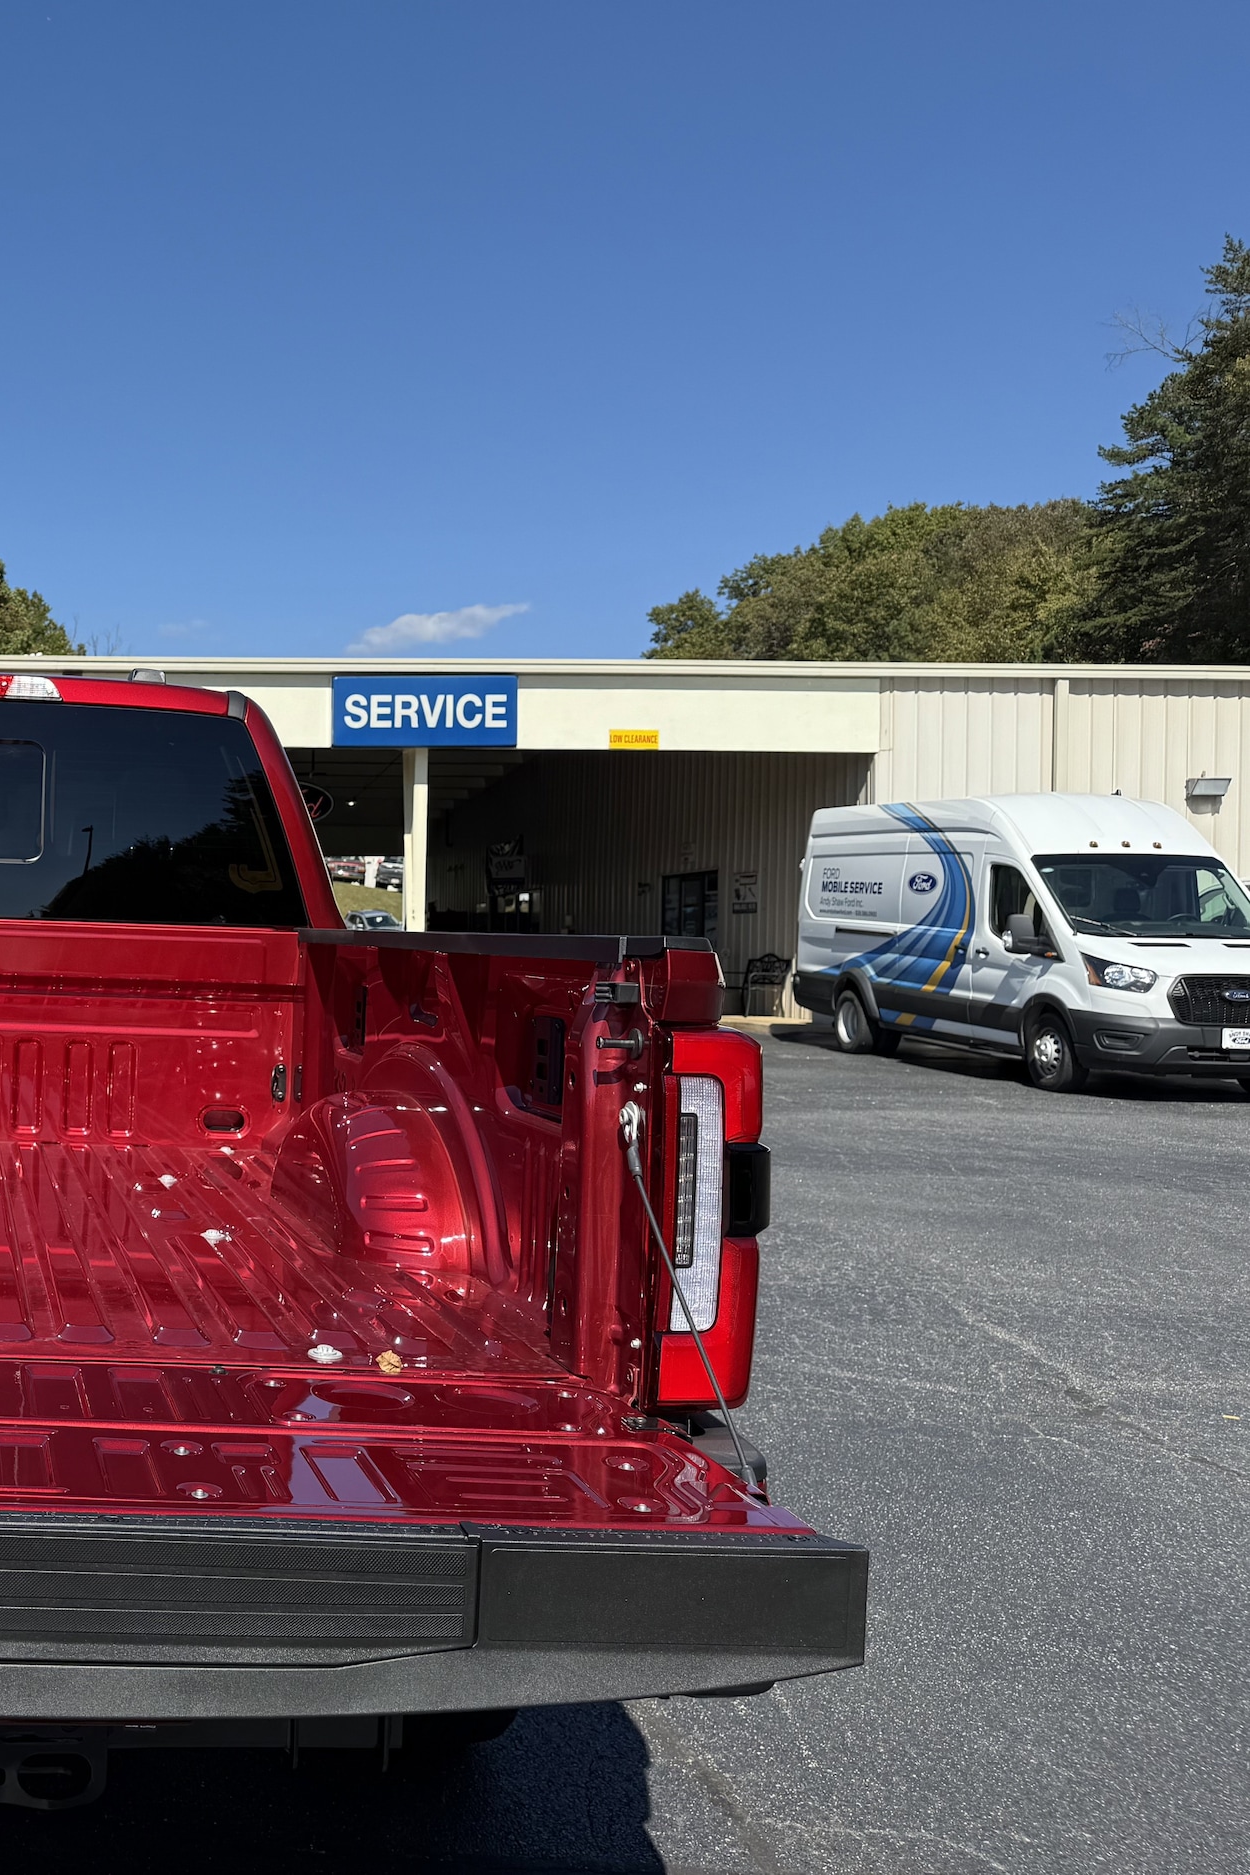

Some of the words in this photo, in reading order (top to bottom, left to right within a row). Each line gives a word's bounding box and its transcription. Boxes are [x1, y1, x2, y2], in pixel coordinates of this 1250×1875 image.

[344, 694, 507, 729] SERVICE
[610, 734, 623, 744] LOW
[624, 734, 658, 744] CLEARANCE
[823, 867, 840, 880] FORD
[821, 881, 848, 894] MOBILE
[849, 881, 883, 895] SERVICE
[913, 874, 933, 890] Ford
[820, 896, 831, 908] Andy
[844, 897, 856, 908] Ford
